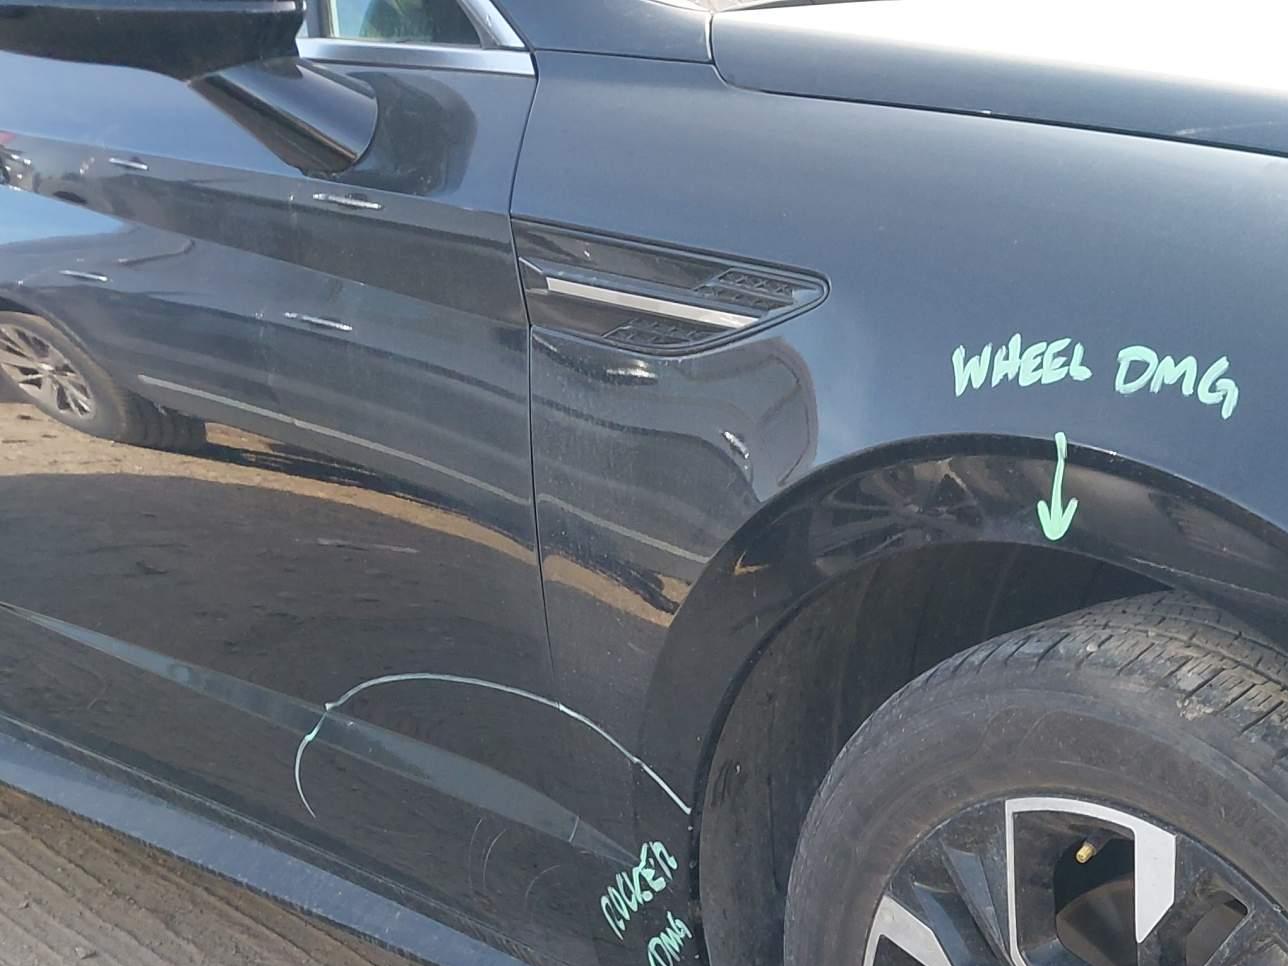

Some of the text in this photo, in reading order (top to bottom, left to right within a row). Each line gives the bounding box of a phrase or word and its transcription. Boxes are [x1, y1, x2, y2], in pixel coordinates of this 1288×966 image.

[951, 334, 1239, 418] WHEEL DMG
[600, 840, 678, 940] ROCKER
